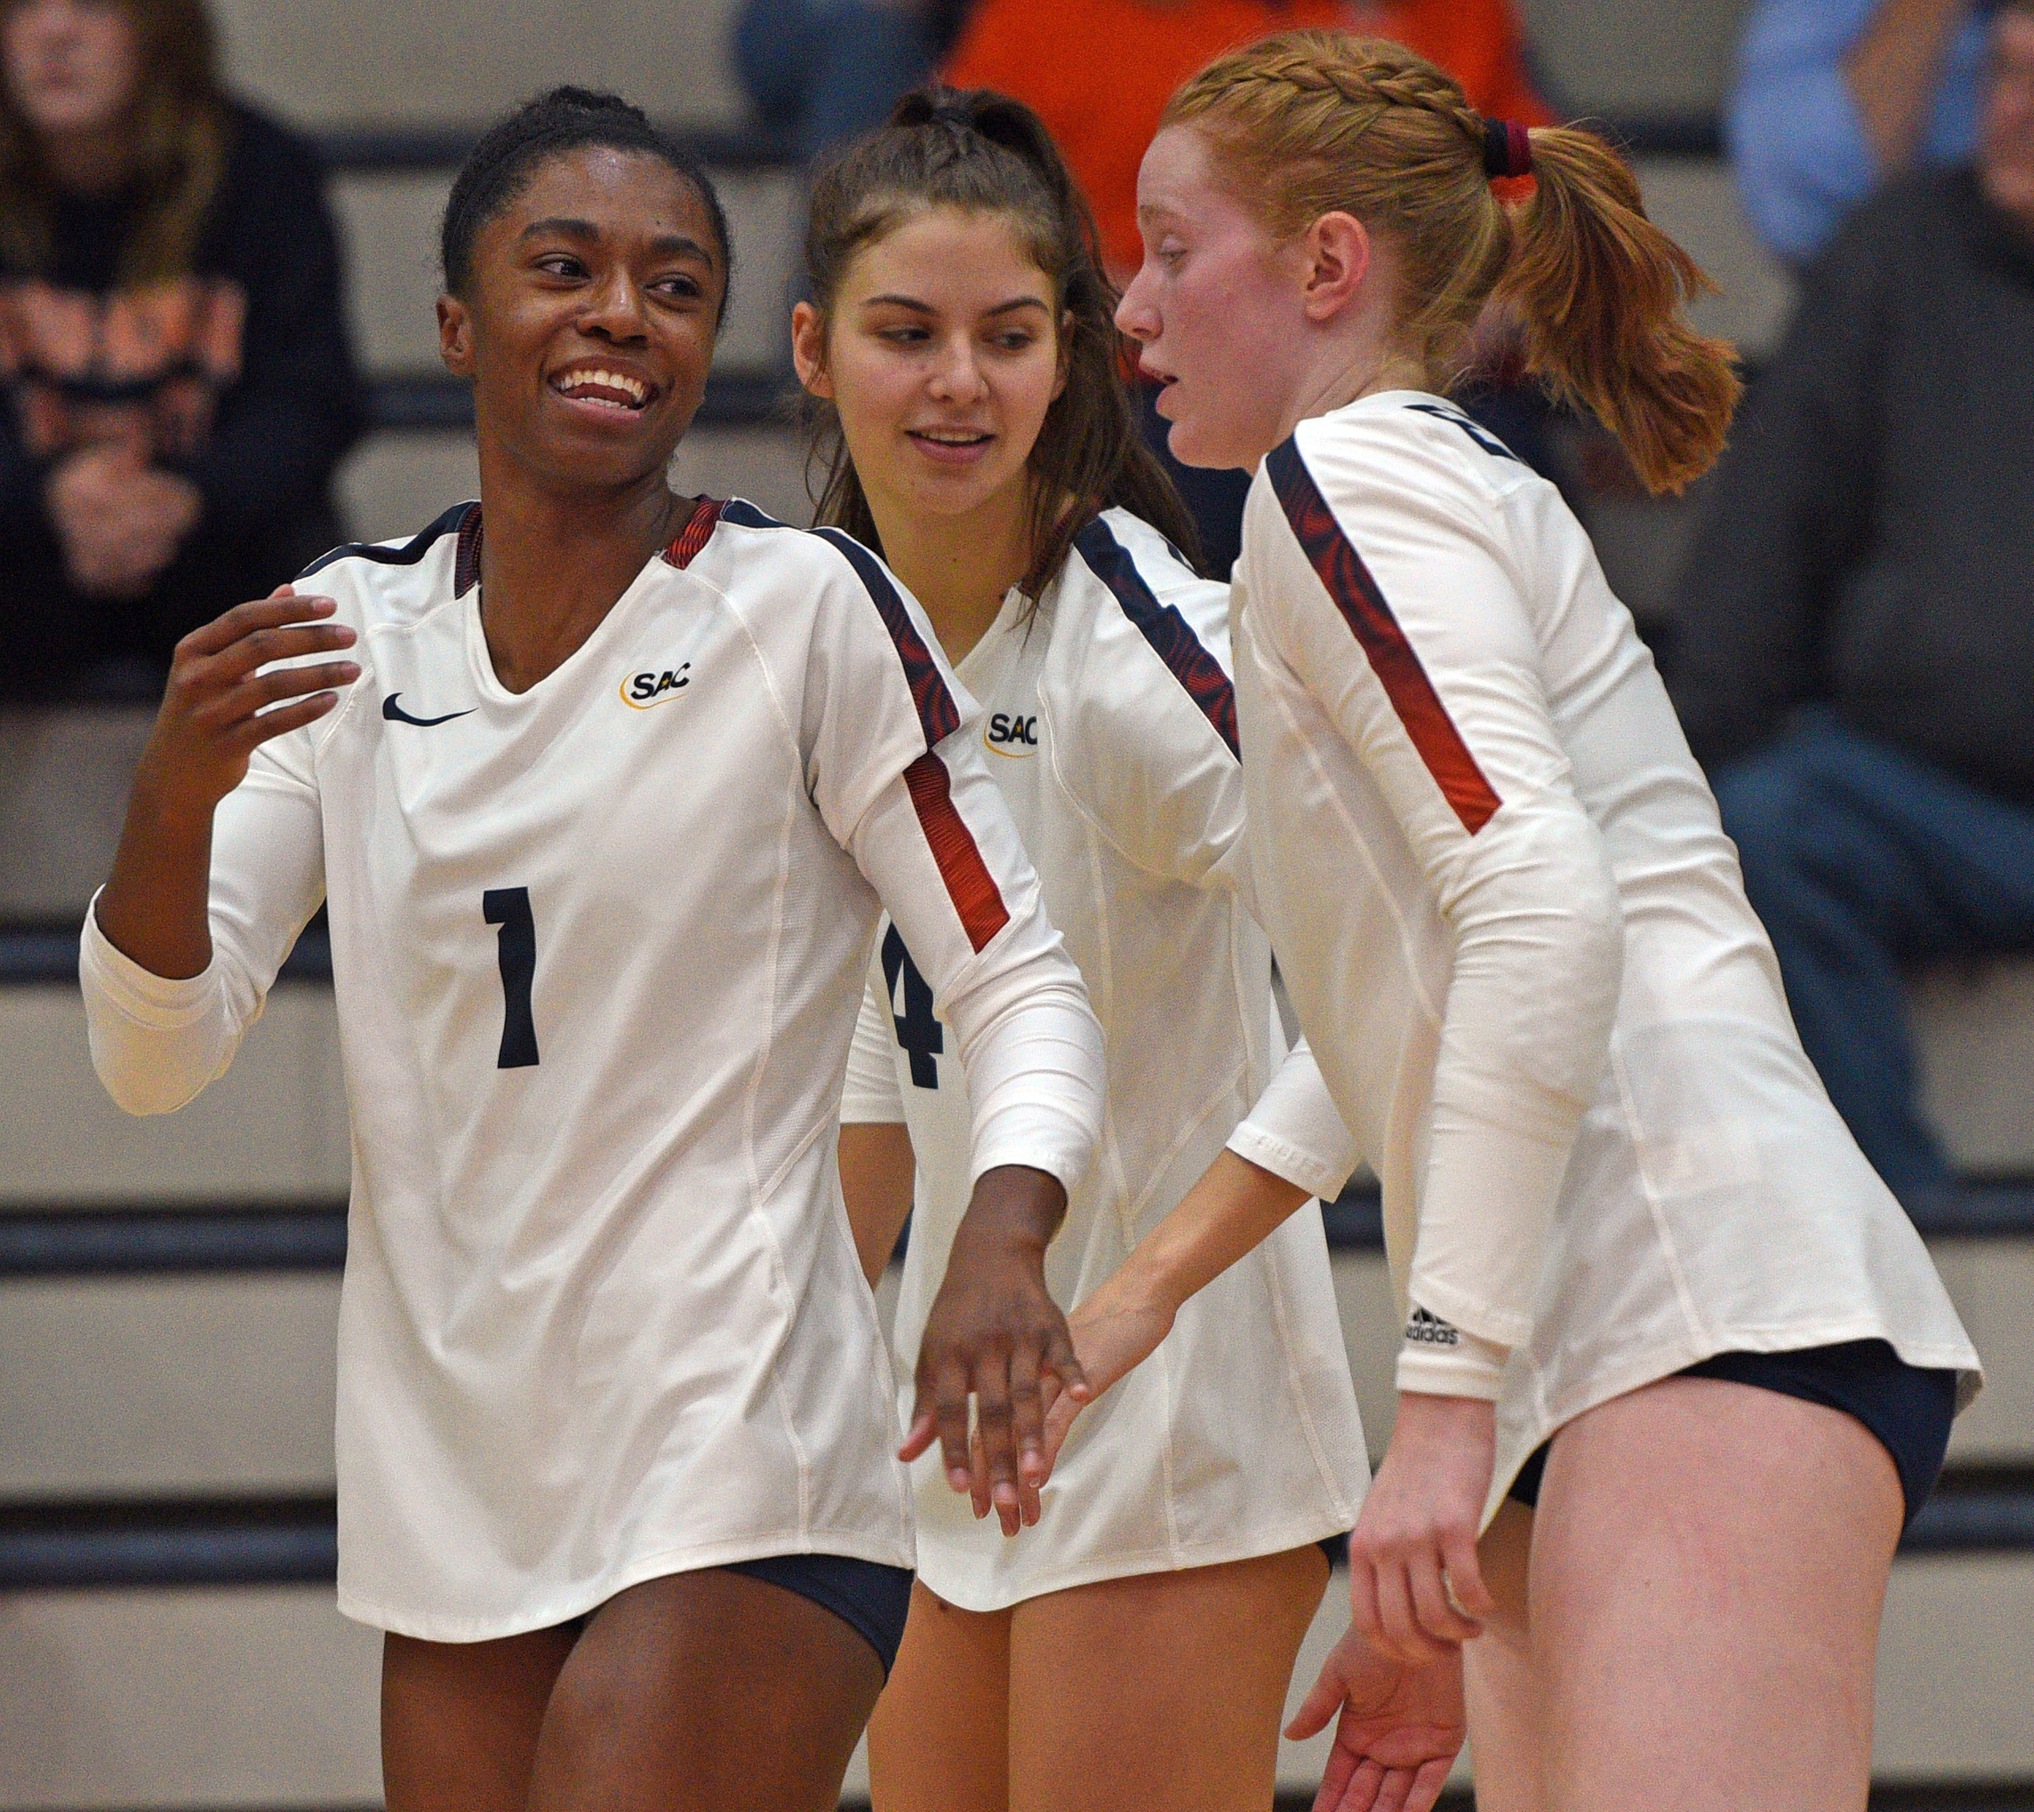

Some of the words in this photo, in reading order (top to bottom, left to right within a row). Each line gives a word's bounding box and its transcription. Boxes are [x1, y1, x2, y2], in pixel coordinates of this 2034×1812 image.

[631, 662, 691, 700] SAC
[988, 713, 1038, 745] SAC
[483, 886, 540, 1069] 1
[881, 919, 944, 1089] 4
[1405, 1320, 1459, 1345] adidas
